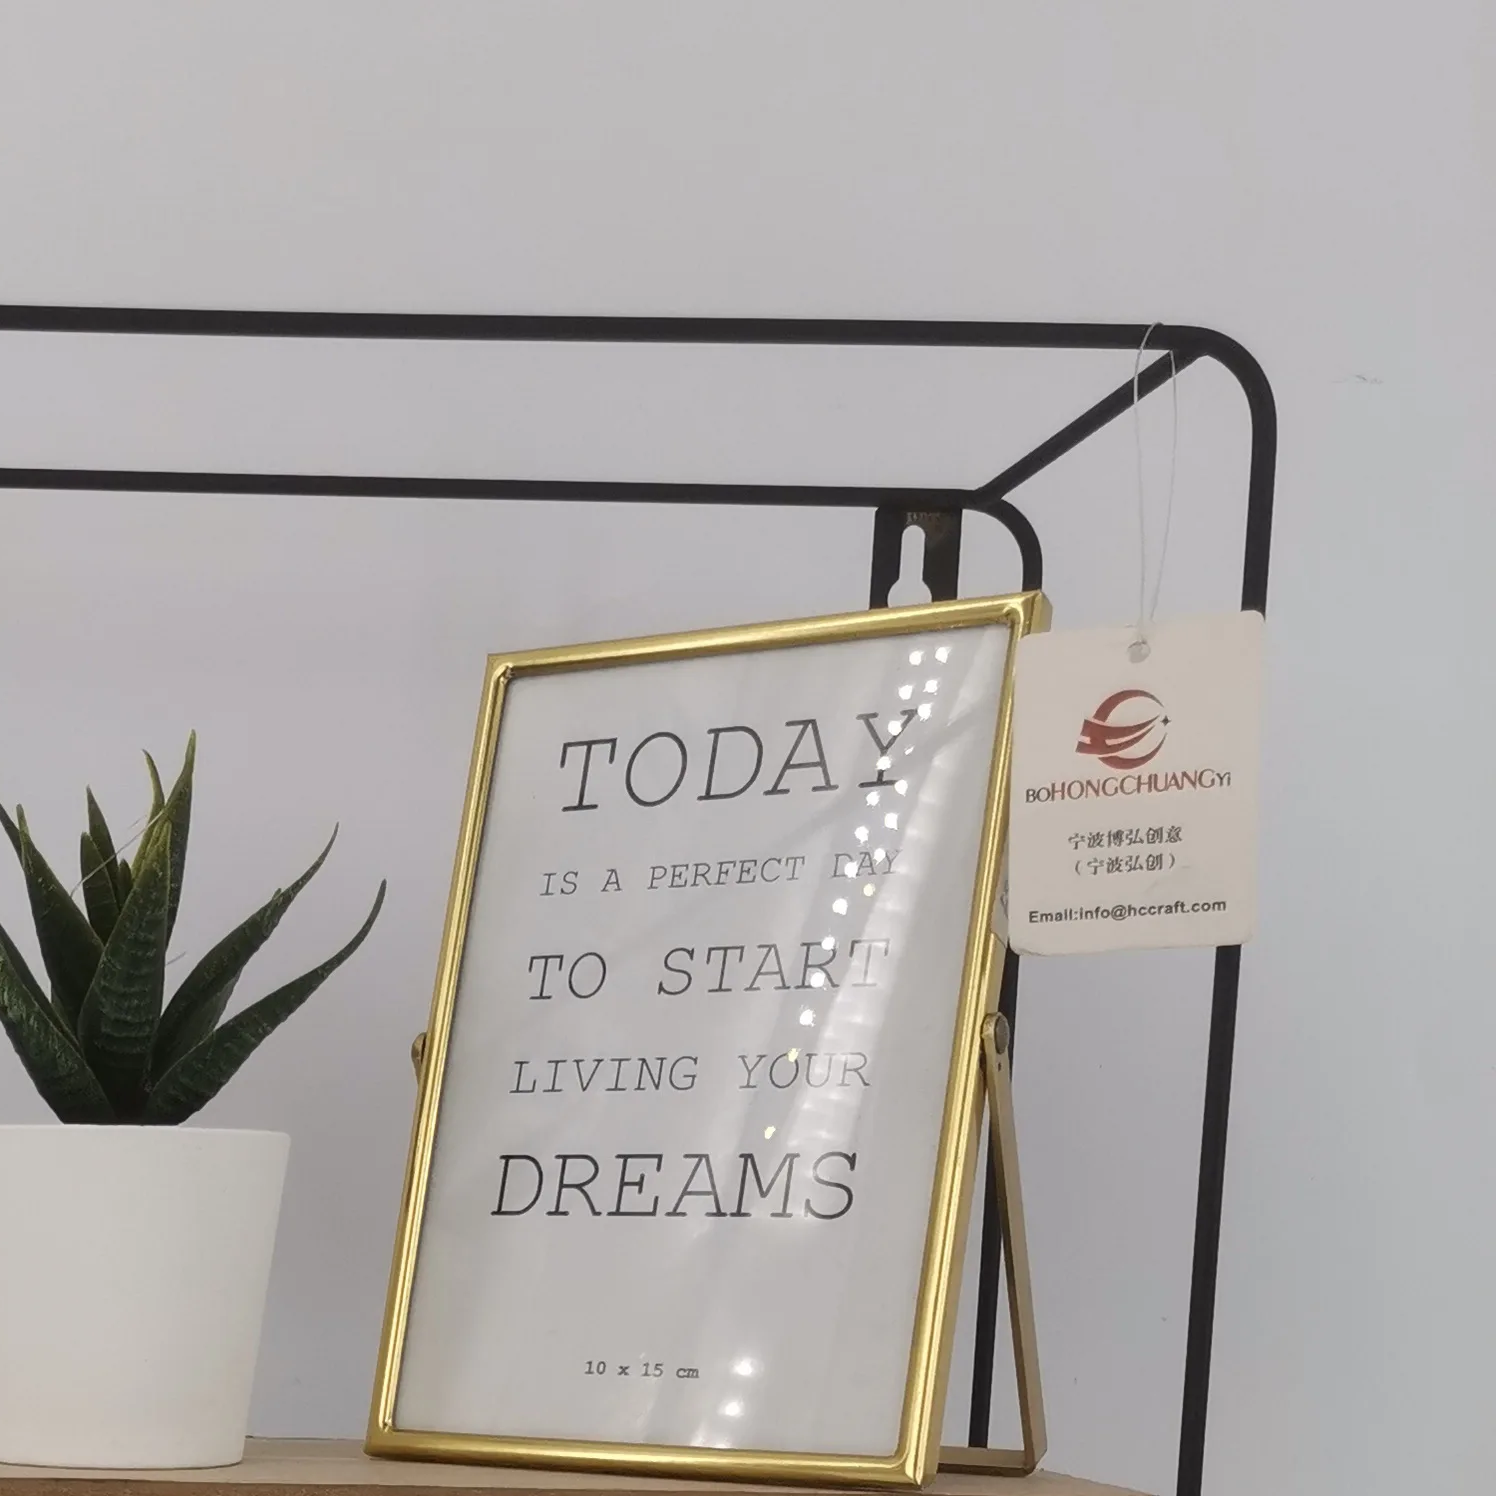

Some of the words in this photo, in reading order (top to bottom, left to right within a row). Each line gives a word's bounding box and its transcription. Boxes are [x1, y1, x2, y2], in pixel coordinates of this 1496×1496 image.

[559, 709, 919, 812] TODAY
[1068, 825, 1183, 850] 宁波博弘创意
[540, 870, 579, 897] IS
[601, 868, 623, 893] A
[647, 855, 806, 890] PERFECT
[830, 848, 905, 880] DAY
[528, 951, 608, 1000] TO
[657, 938, 891, 997] START
[510, 1056, 699, 1095] LIVING
[738, 1050, 872, 1091] YOUR
[491, 1150, 858, 1221] DREAMS
[584, 1360, 608, 1376] 10
[617, 1365, 630, 1376] x
[641, 1362, 664, 1378] 15
[675, 1366, 700, 1380] cm
